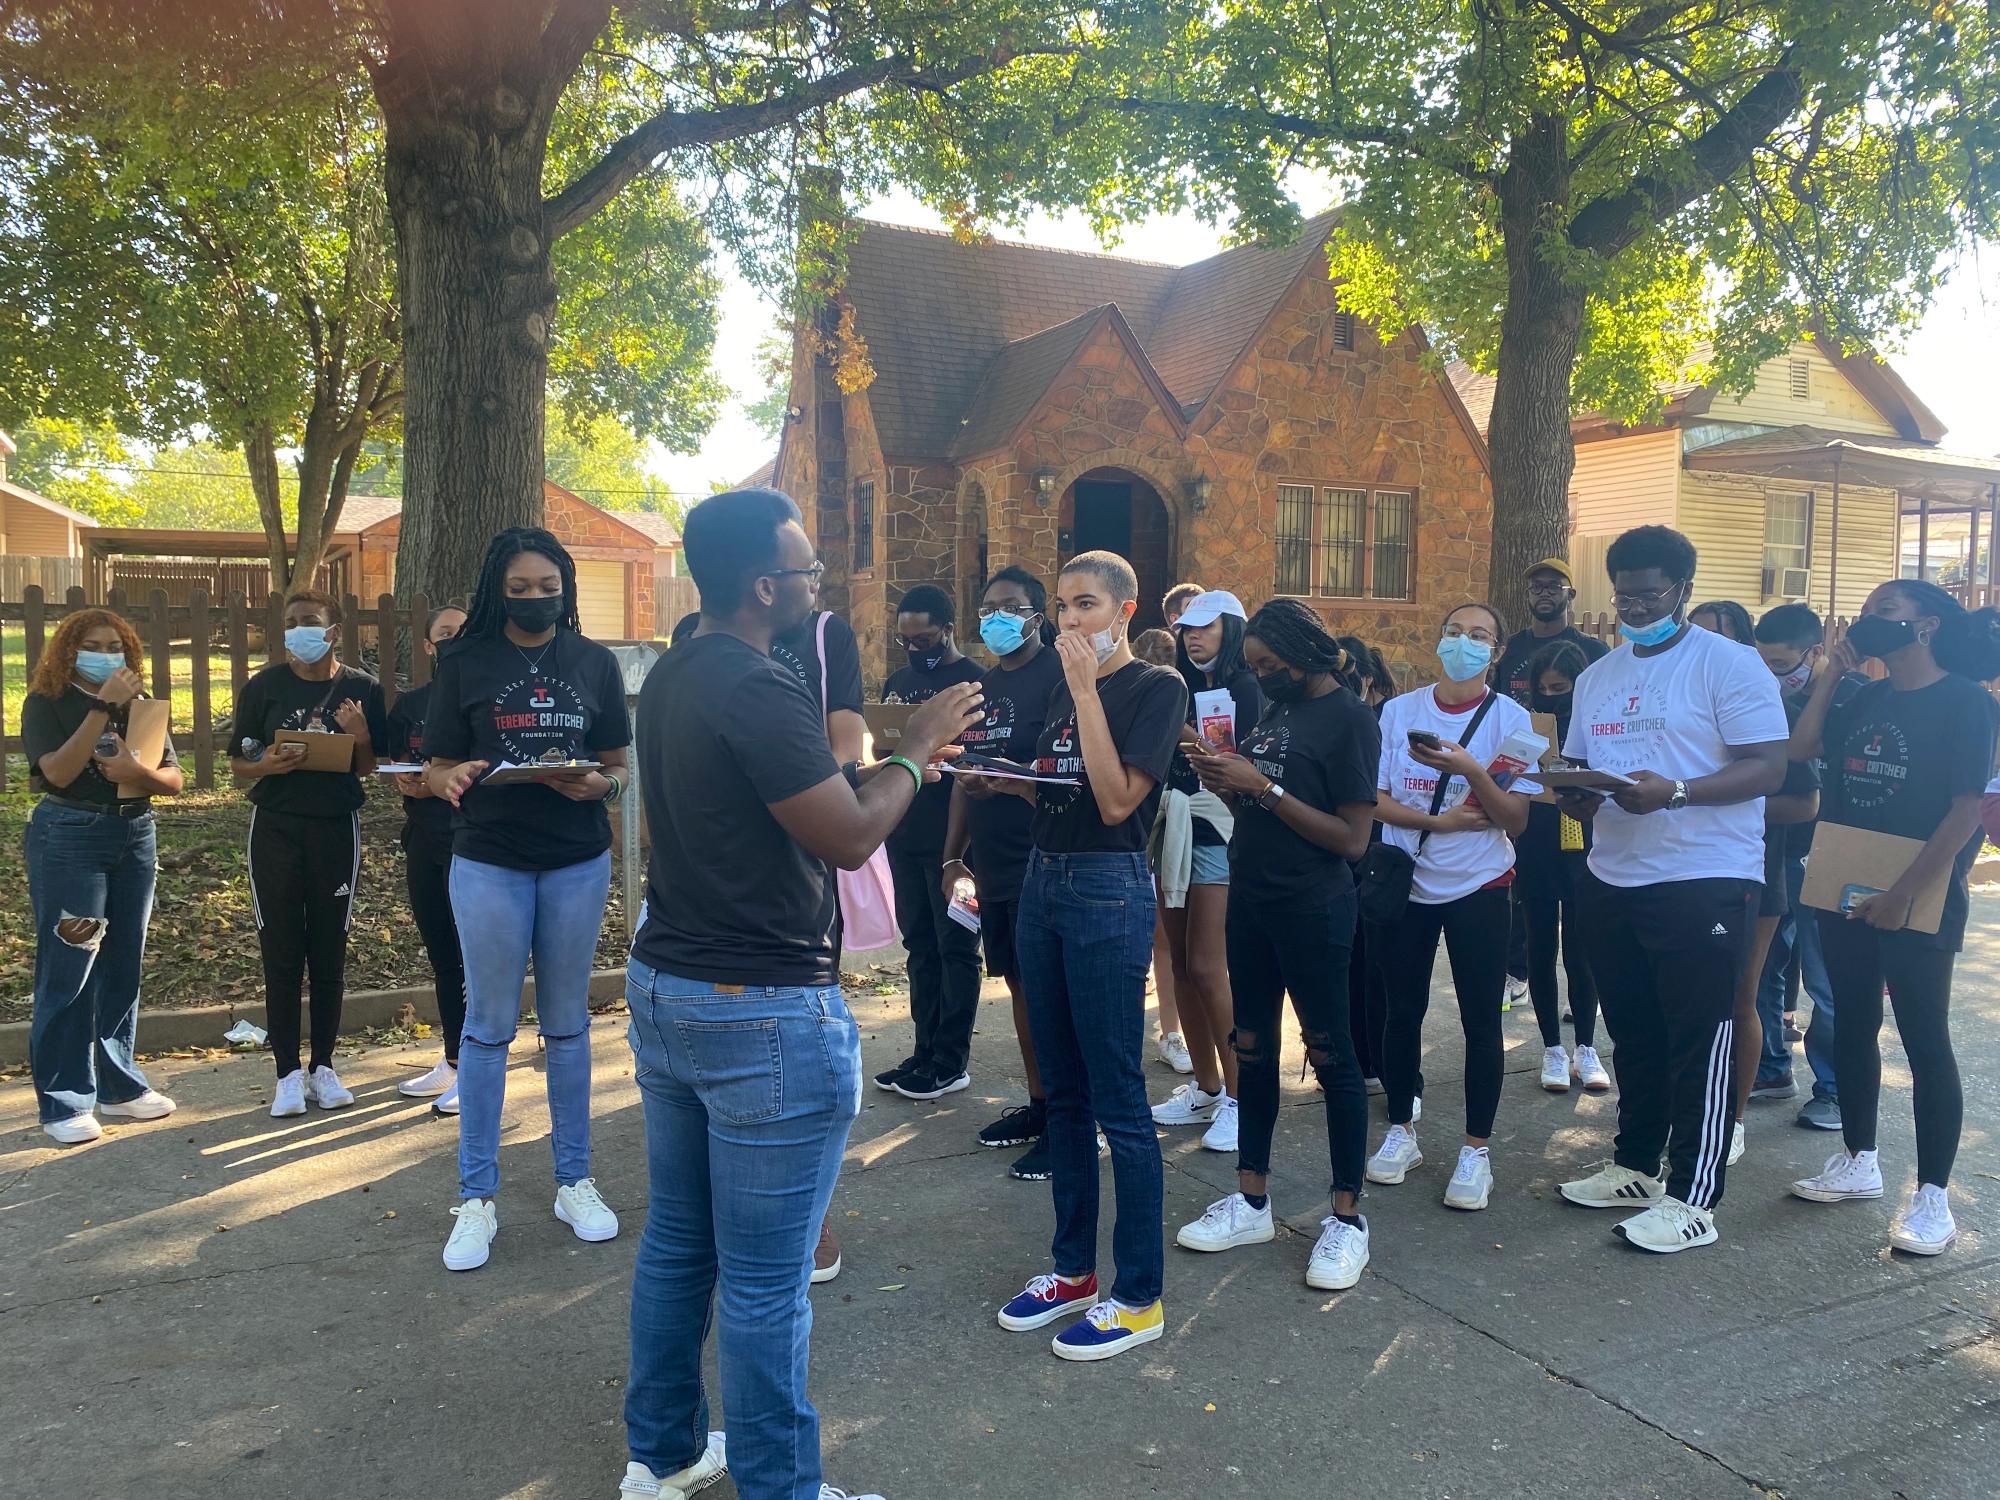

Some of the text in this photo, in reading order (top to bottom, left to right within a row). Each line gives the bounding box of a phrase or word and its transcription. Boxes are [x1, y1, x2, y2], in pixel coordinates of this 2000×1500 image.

[494, 679, 526, 712] BELIEF
[534, 676, 584, 711] ATTITUDE
[494, 712, 584, 730] TERENCE CRUTCHER
[1590, 717, 1667, 737] TERENCE CRUTCHER
[520, 731, 565, 739] FOUNDATION
